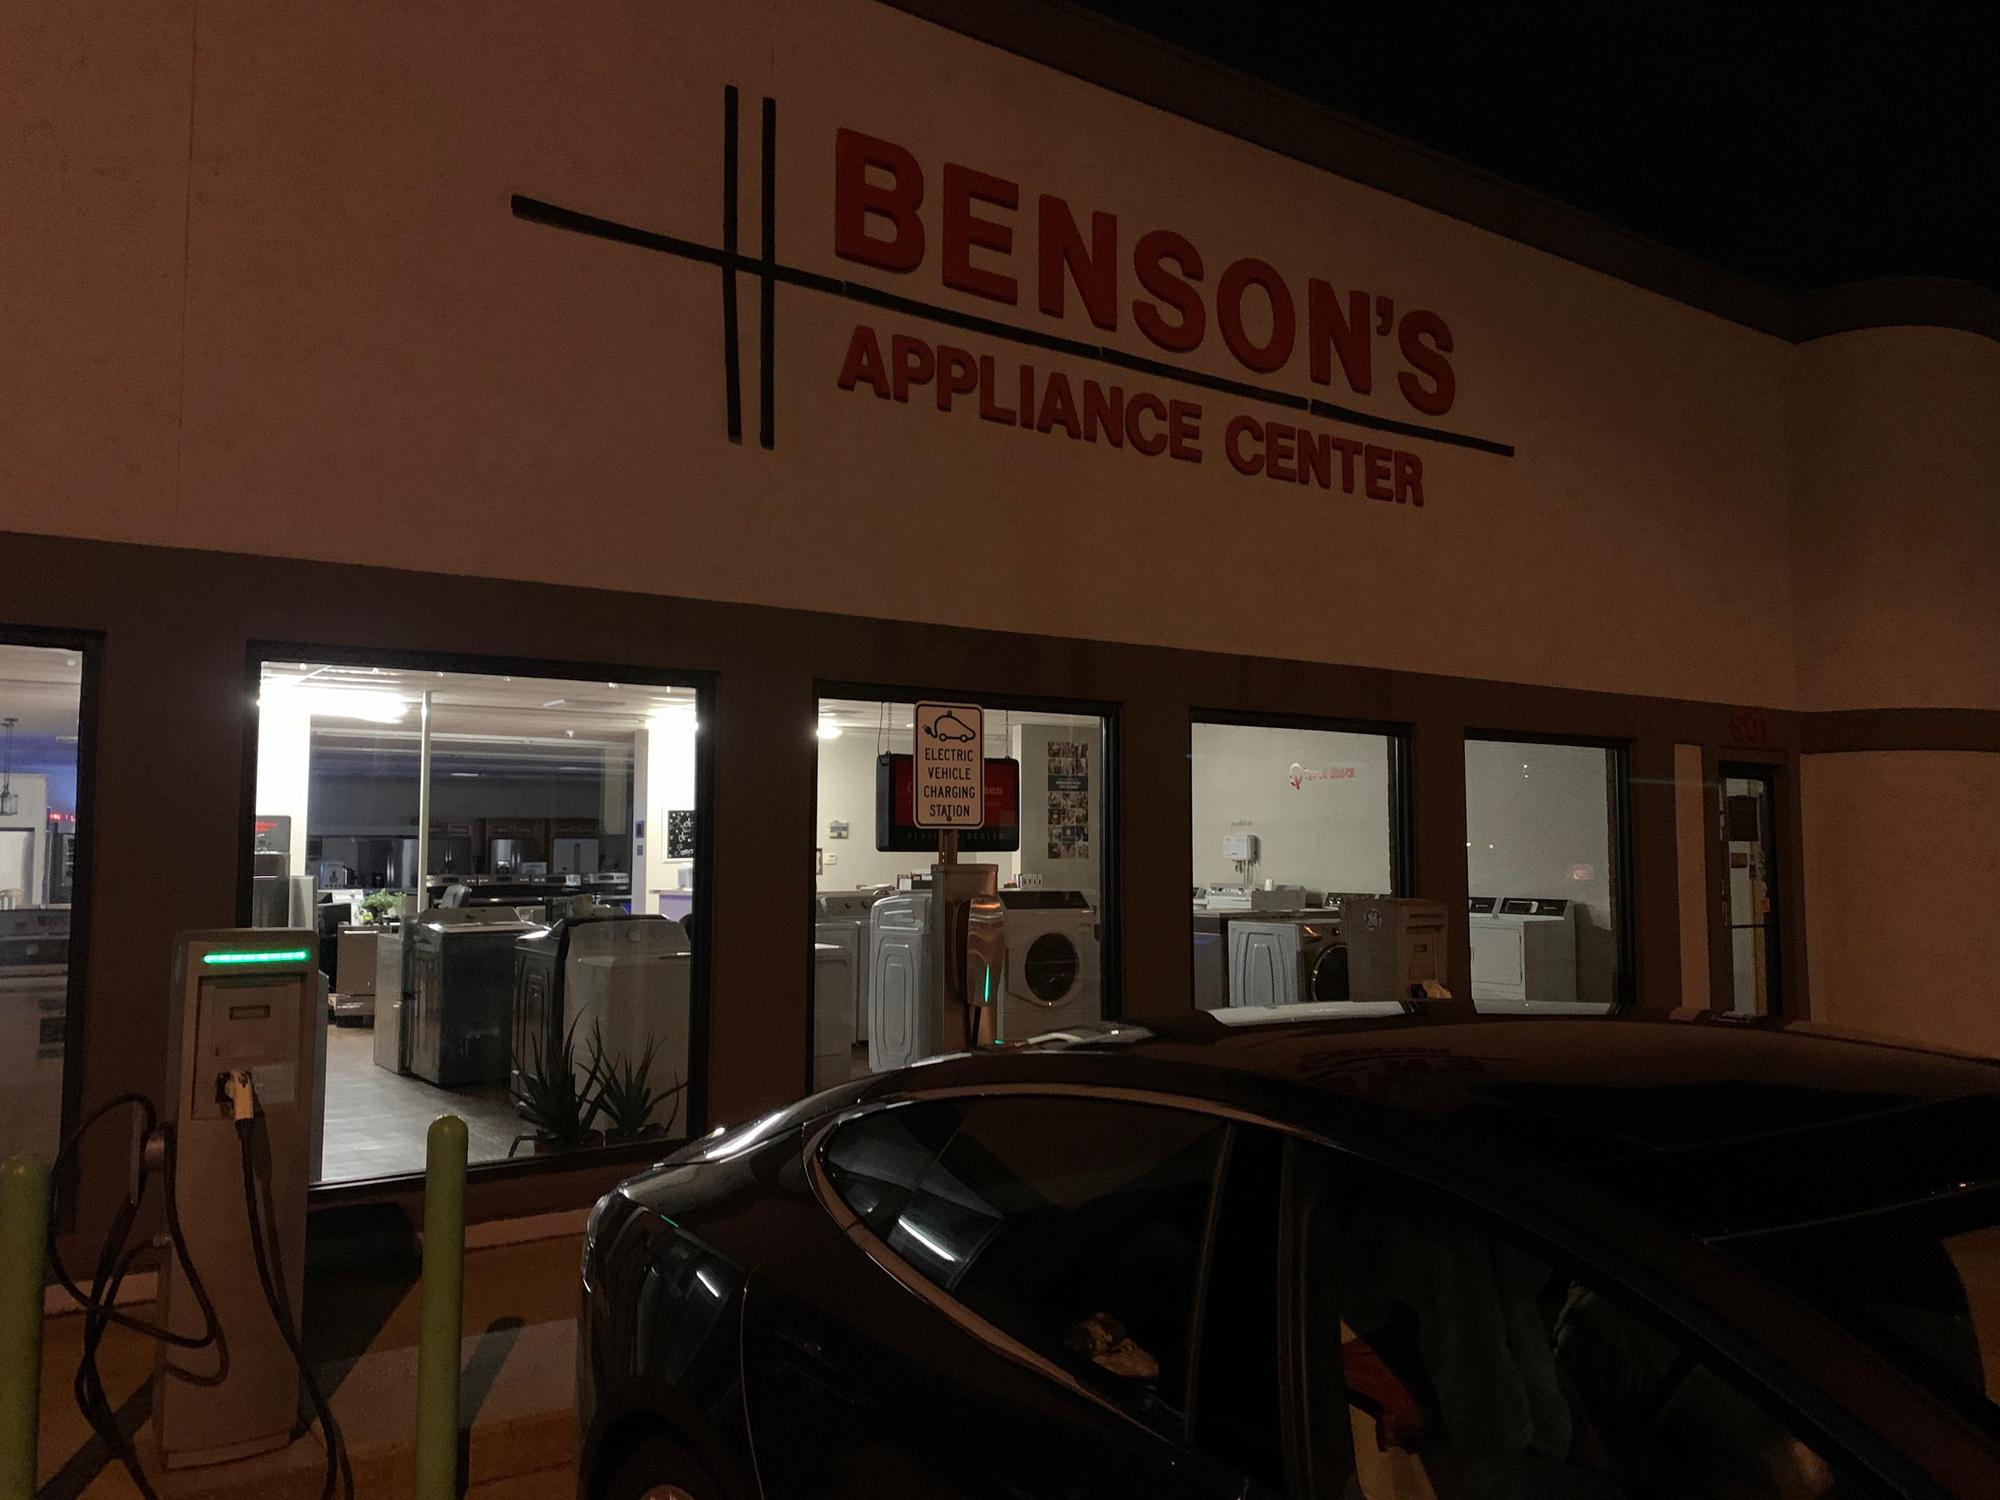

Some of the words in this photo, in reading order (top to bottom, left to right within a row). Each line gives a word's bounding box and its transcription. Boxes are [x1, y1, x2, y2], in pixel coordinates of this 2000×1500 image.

[835, 127, 1456, 416] BENSON'S
[837, 325, 1203, 464] APPLIANCE
[1225, 415, 1425, 507] CENTER
[925, 747, 974, 762] ELECTRIC
[928, 767, 971, 780] VEHICLE
[923, 785, 975, 799] CHARGING
[929, 804, 970, 817] STATION
